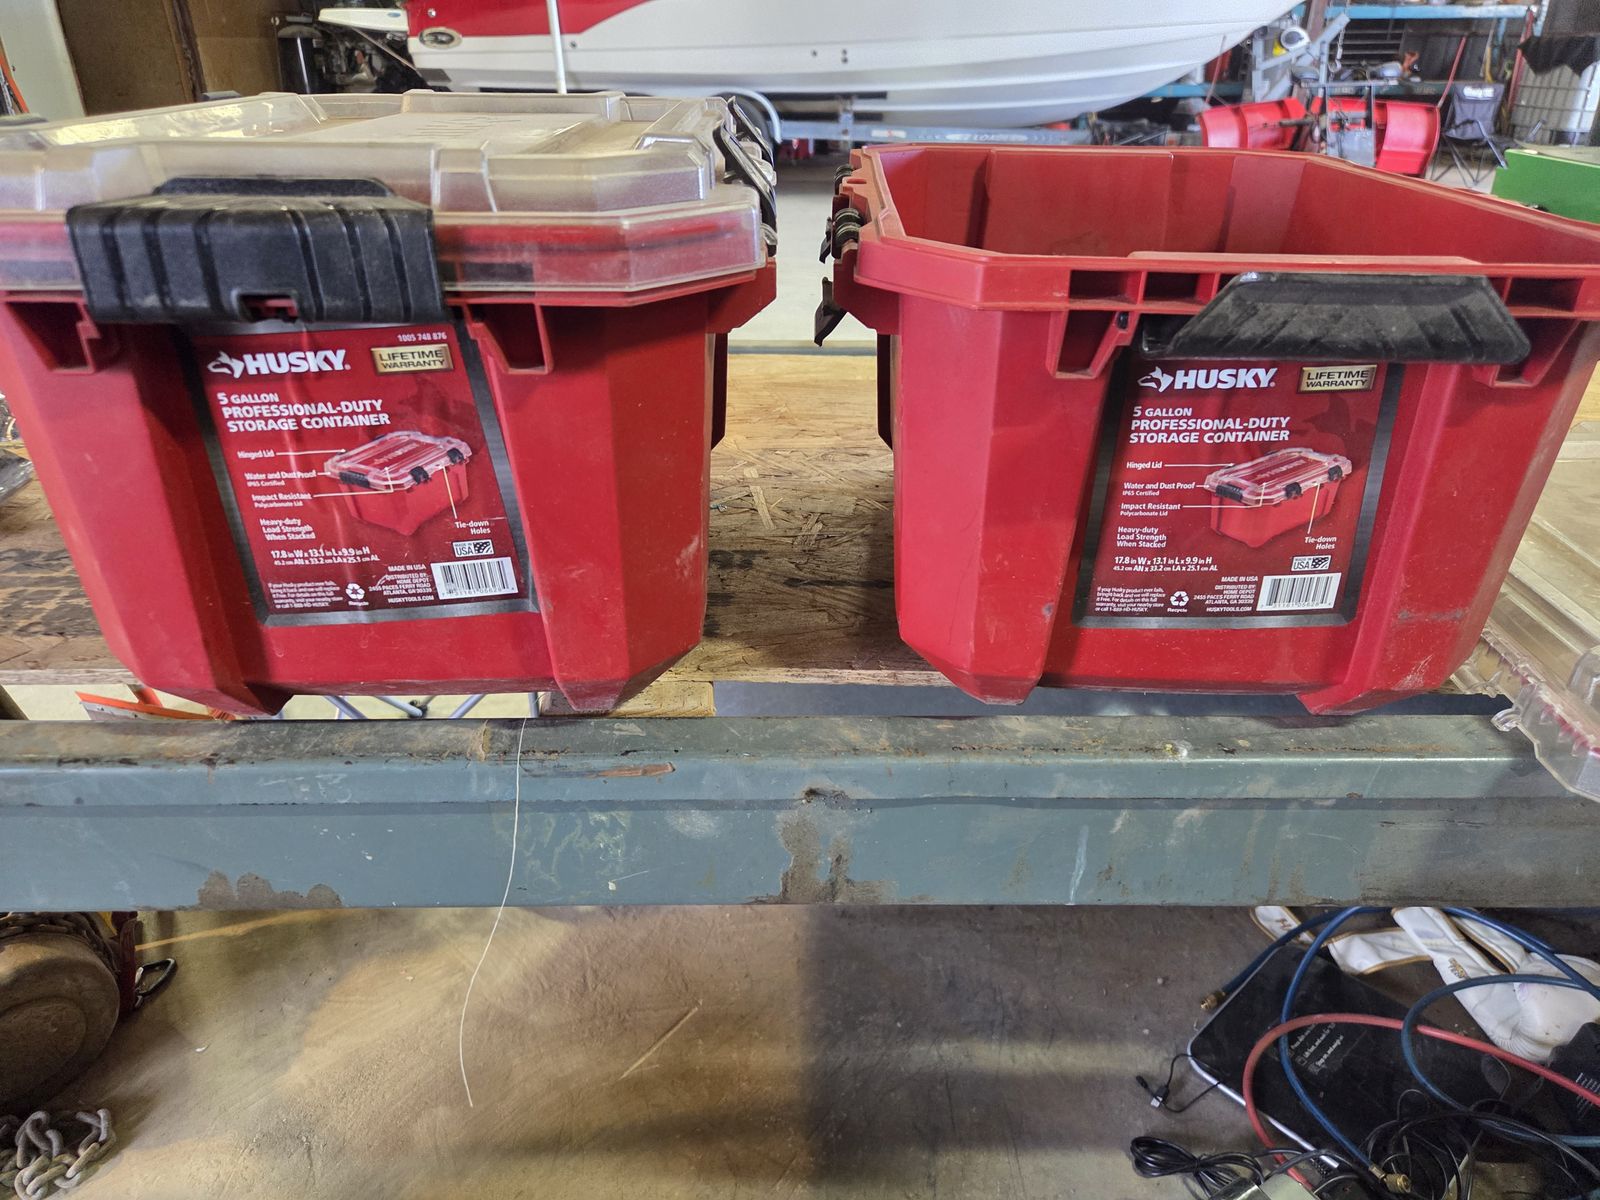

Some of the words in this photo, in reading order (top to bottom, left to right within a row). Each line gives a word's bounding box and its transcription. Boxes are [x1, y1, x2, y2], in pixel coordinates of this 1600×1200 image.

[379, 350, 444, 361] LIFETIME
[243, 350, 346, 375] HUSKY
[381, 360, 445, 369] WARRANTY
[1174, 367, 1278, 390] HUSKY
[1306, 370, 1369, 380] LIFETIME
[1305, 379, 1368, 388] WARRANTY
[217, 392, 228, 405] 5
[230, 393, 279, 404] GALLON
[222, 400, 383, 419] PROFESSIONAL-DUTY
[1133, 406, 1142, 416] 5
[1145, 407, 1192, 417] GALLON
[227, 417, 298, 433] STORAGE
[301, 413, 390, 429] CONTAINER
[1130, 417, 1290, 431] PROFESSIONAL-DUTY
[1129, 432, 1199, 444] STORAGE
[1203, 430, 1290, 444] CONTAINER
[237, 450, 262, 459] Hinged
[1126, 462, 1150, 470] Hinged
[298, 470, 316, 478] Proof
[271, 550, 287, 558] 17.8
[308, 549, 324, 557] 13.1
[456, 547, 473, 555] USA
